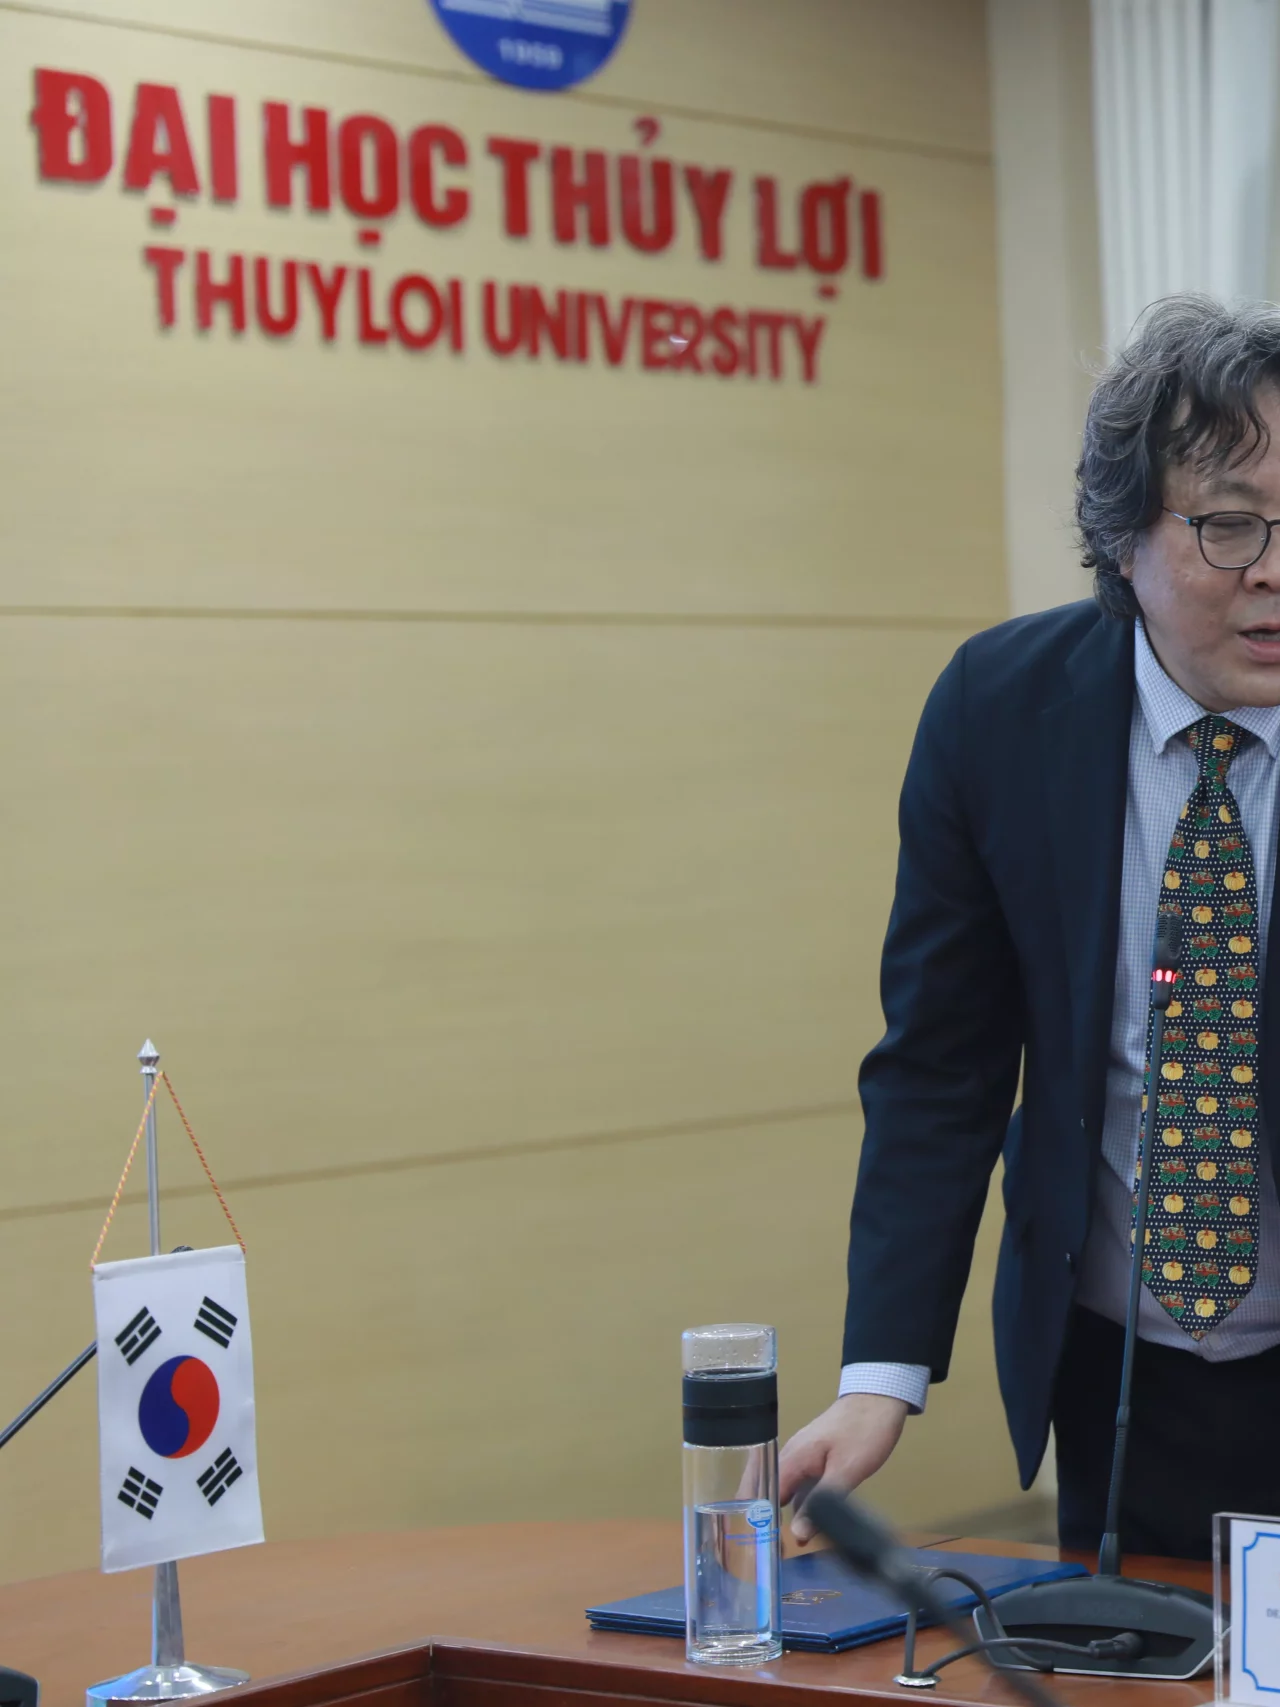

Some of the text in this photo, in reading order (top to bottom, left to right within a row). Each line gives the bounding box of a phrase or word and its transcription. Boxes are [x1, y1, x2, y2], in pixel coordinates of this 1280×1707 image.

[31, 67, 883, 301] ĐẠI HỌC THỦY LỢI
[145, 245, 827, 385] THUYLOI UNIVERSITY
